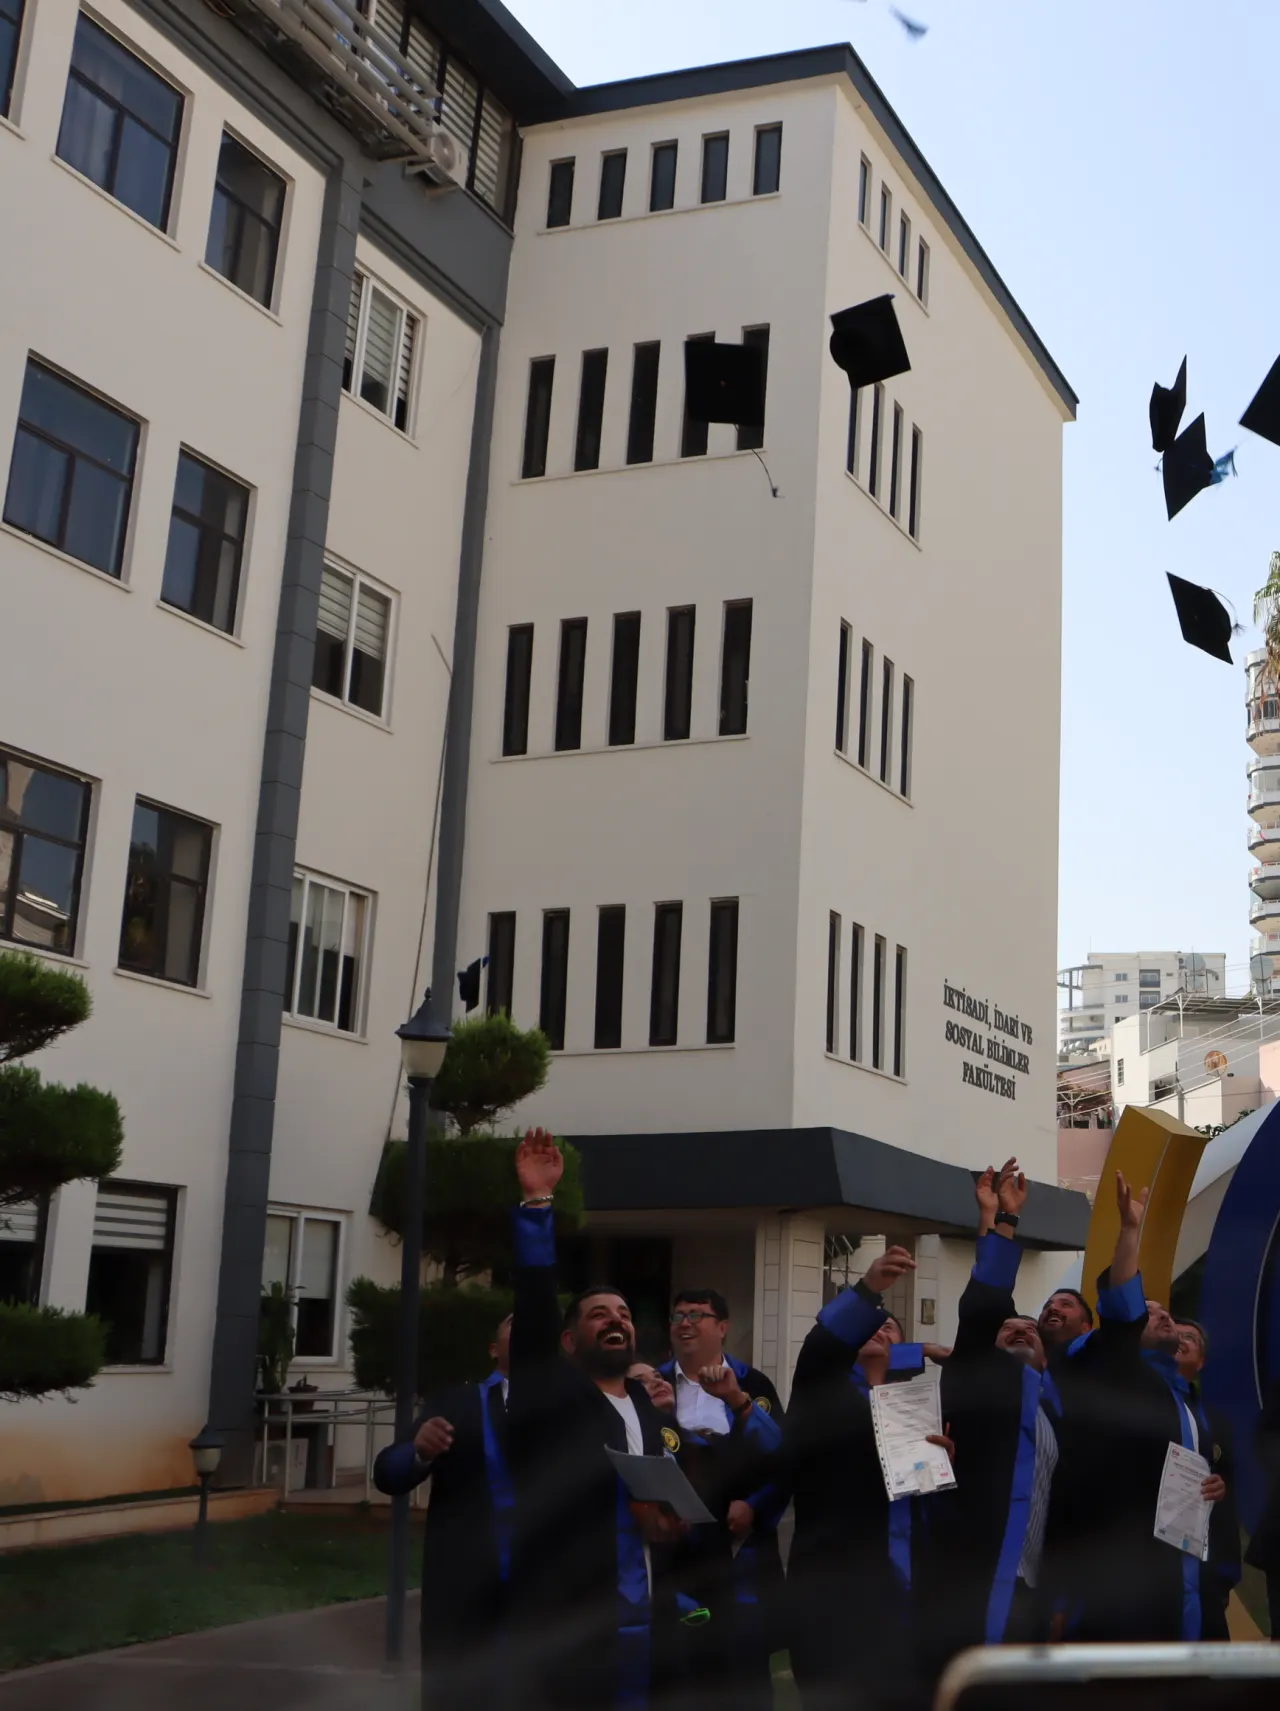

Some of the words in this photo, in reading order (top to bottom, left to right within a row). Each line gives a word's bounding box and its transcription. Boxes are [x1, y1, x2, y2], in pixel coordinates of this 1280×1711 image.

[943, 978, 991, 1031] İKTİSADİ,
[994, 1003, 1019, 1039] İDARİ
[1021, 1022, 1033, 1045] VE
[945, 1020, 984, 1056] SOSYAL
[986, 1035, 1030, 1075] BİLİMLER
[962, 1061, 1016, 1100] FAKÜLTESİ
